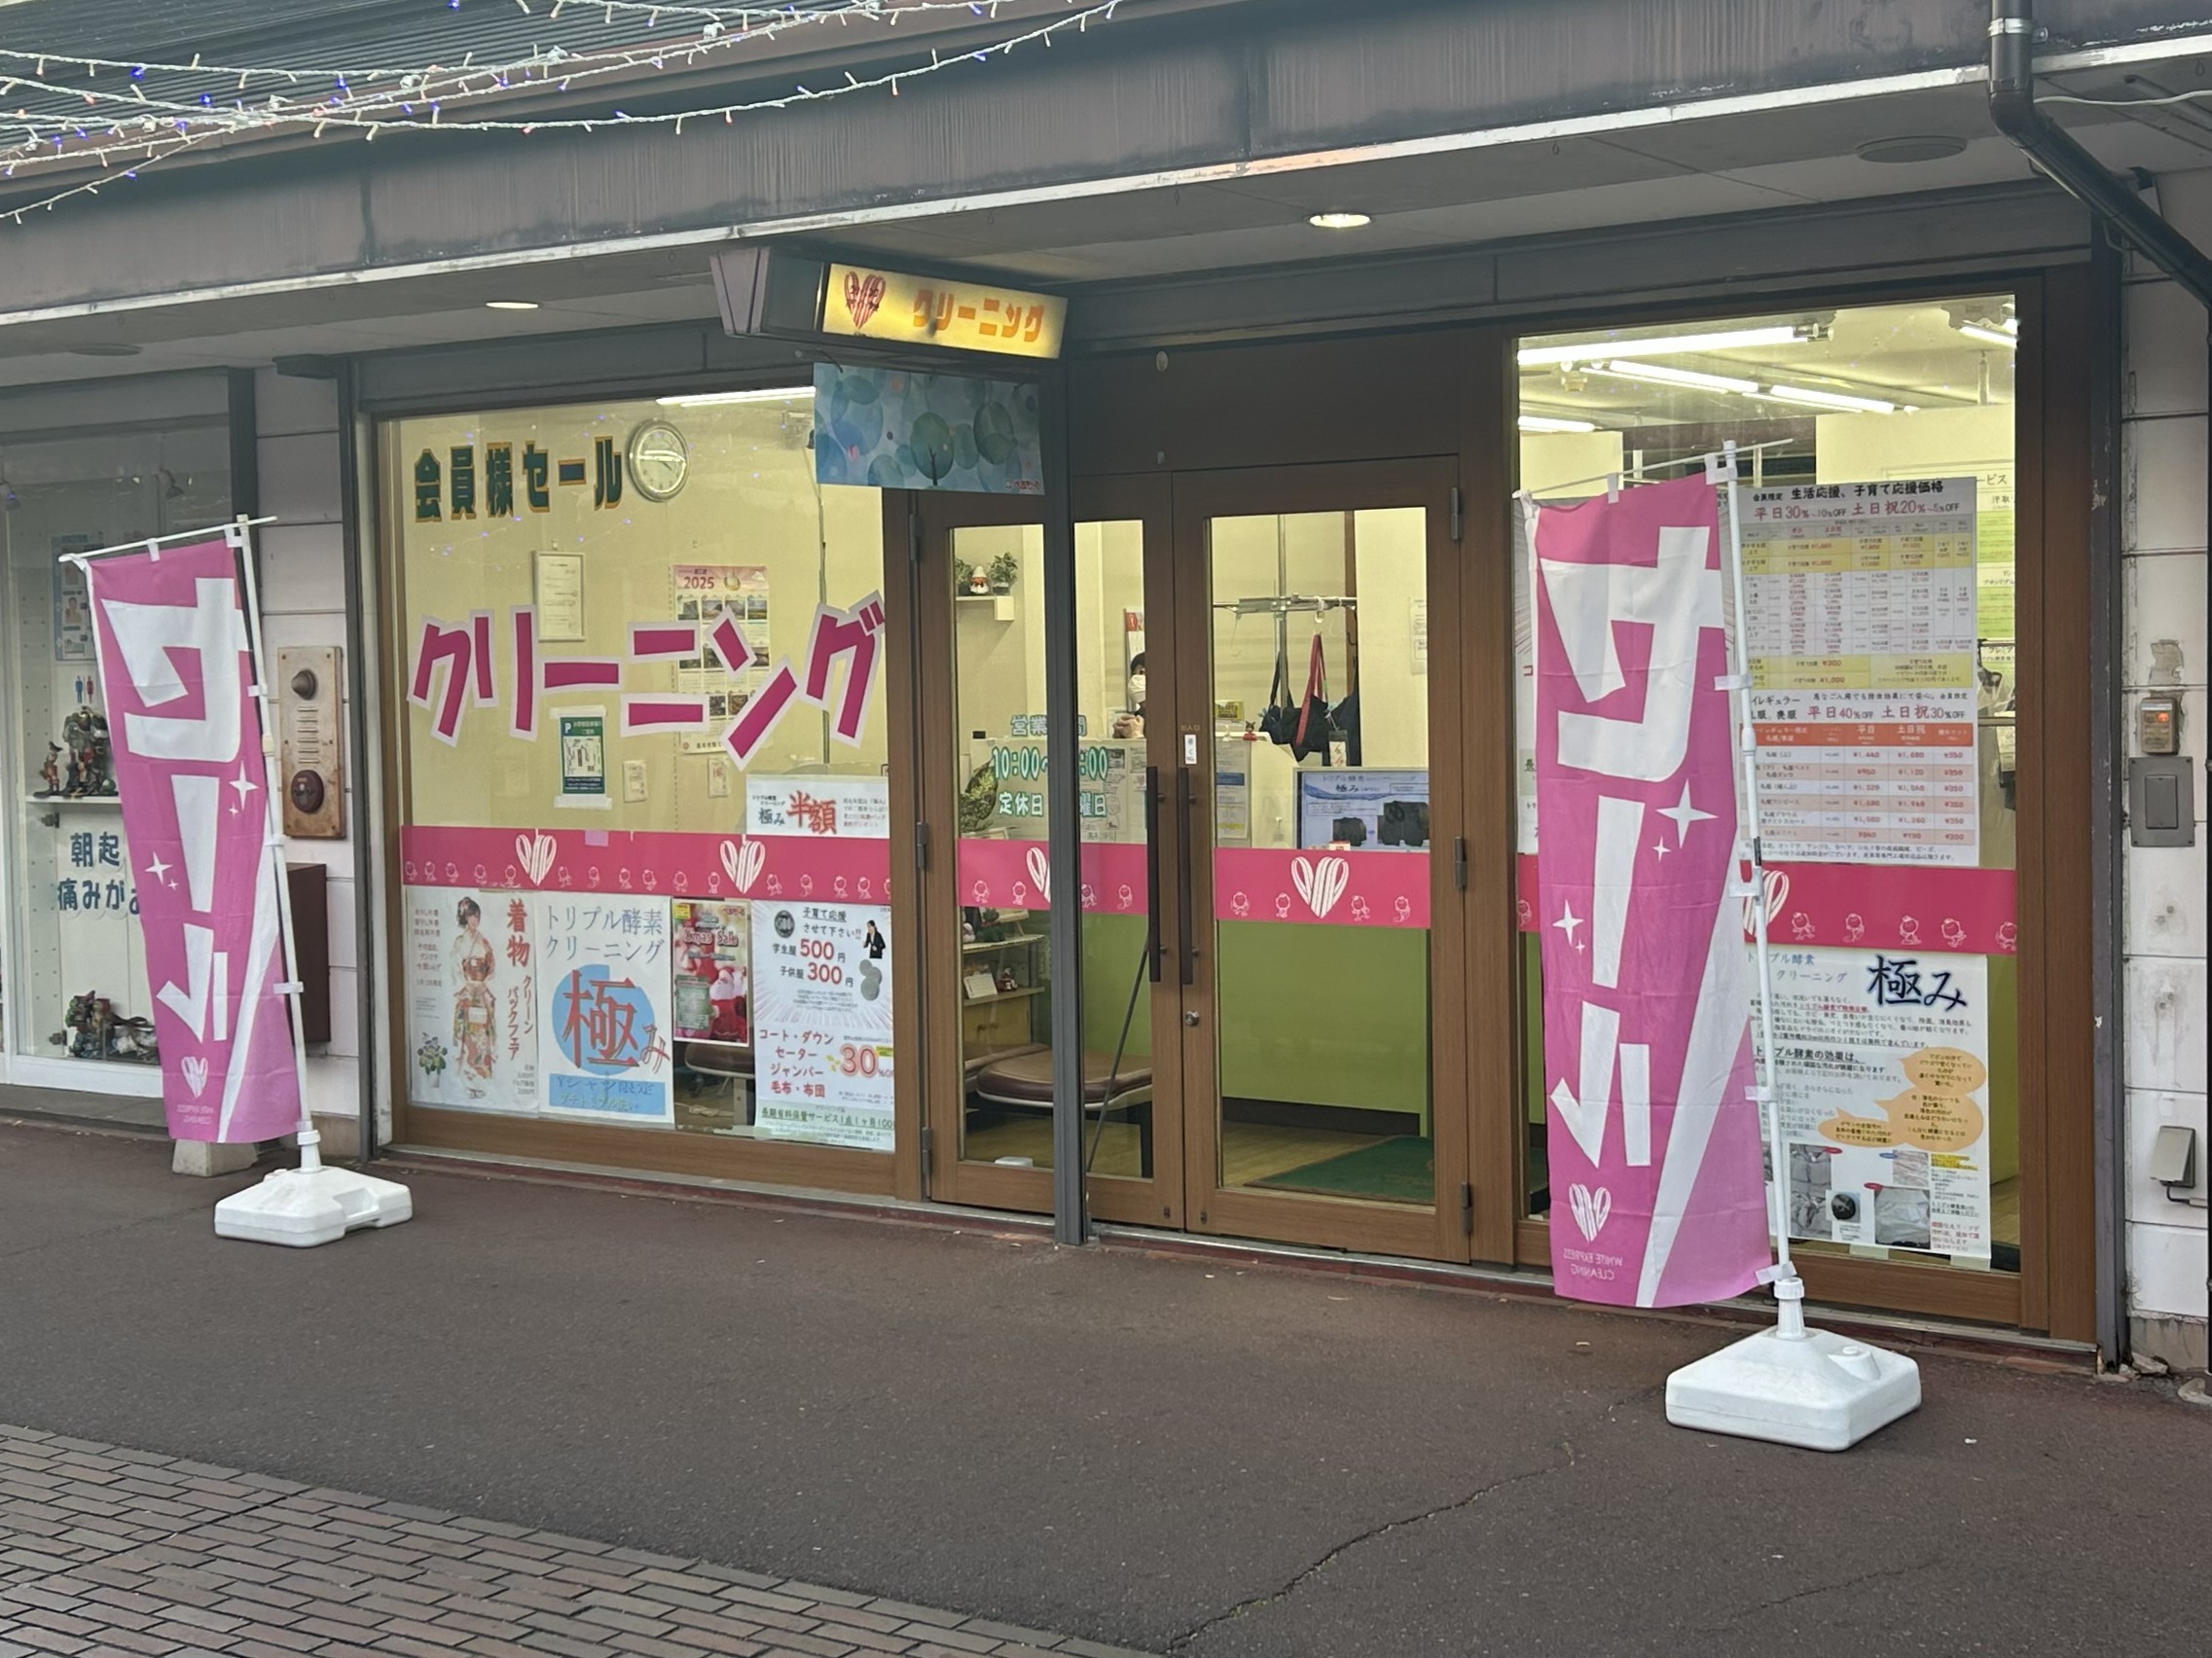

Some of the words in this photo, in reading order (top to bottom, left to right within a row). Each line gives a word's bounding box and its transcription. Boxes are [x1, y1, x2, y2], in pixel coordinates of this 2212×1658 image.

[913, 289, 1045, 342] クリーニング
[415, 436, 623, 523] 会員様セール
[1791, 480, 1944, 500] 生活応援、子育て応援価格
[684, 576, 715, 590] 2025
[409, 592, 885, 770] クリーニング
[564, 722, 572, 734] P
[759, 808, 785, 826] 極み
[786, 789, 837, 835] 半額
[998, 791, 1044, 816] 定休日
[1079, 793, 1107, 817] 曜日
[71, 831, 120, 868] 朝起
[547, 905, 663, 935] トリプル酵素
[803, 907, 847, 922] 子育て応援
[506, 897, 530, 967] 着物
[717, 928, 740, 946] Sale
[546, 935, 666, 965] クリーニング
[773, 943, 797, 955] 学生服
[800, 938, 835, 960] 500
[838, 953, 846, 963] 円
[1748, 952, 1816, 965] トプル酵素
[780, 965, 805, 980] 子供服
[807, 961, 842, 985] 300
[845, 977, 853, 988] 円
[1776, 971, 1848, 984] クリーニング
[1866, 954, 1968, 1013] 極み
[523, 974, 534, 1035] クリーン
[507, 986, 523, 1062] パックフェア
[562, 968, 671, 1075] 極み
[759, 1028, 834, 1046] コート・ダウン
[776, 1046, 818, 1061] セーター
[840, 1043, 879, 1079] 30
[1756, 1045, 1862, 1063] トプル酵素の効果は、
[771, 1080, 826, 1099] 毛布・布団
